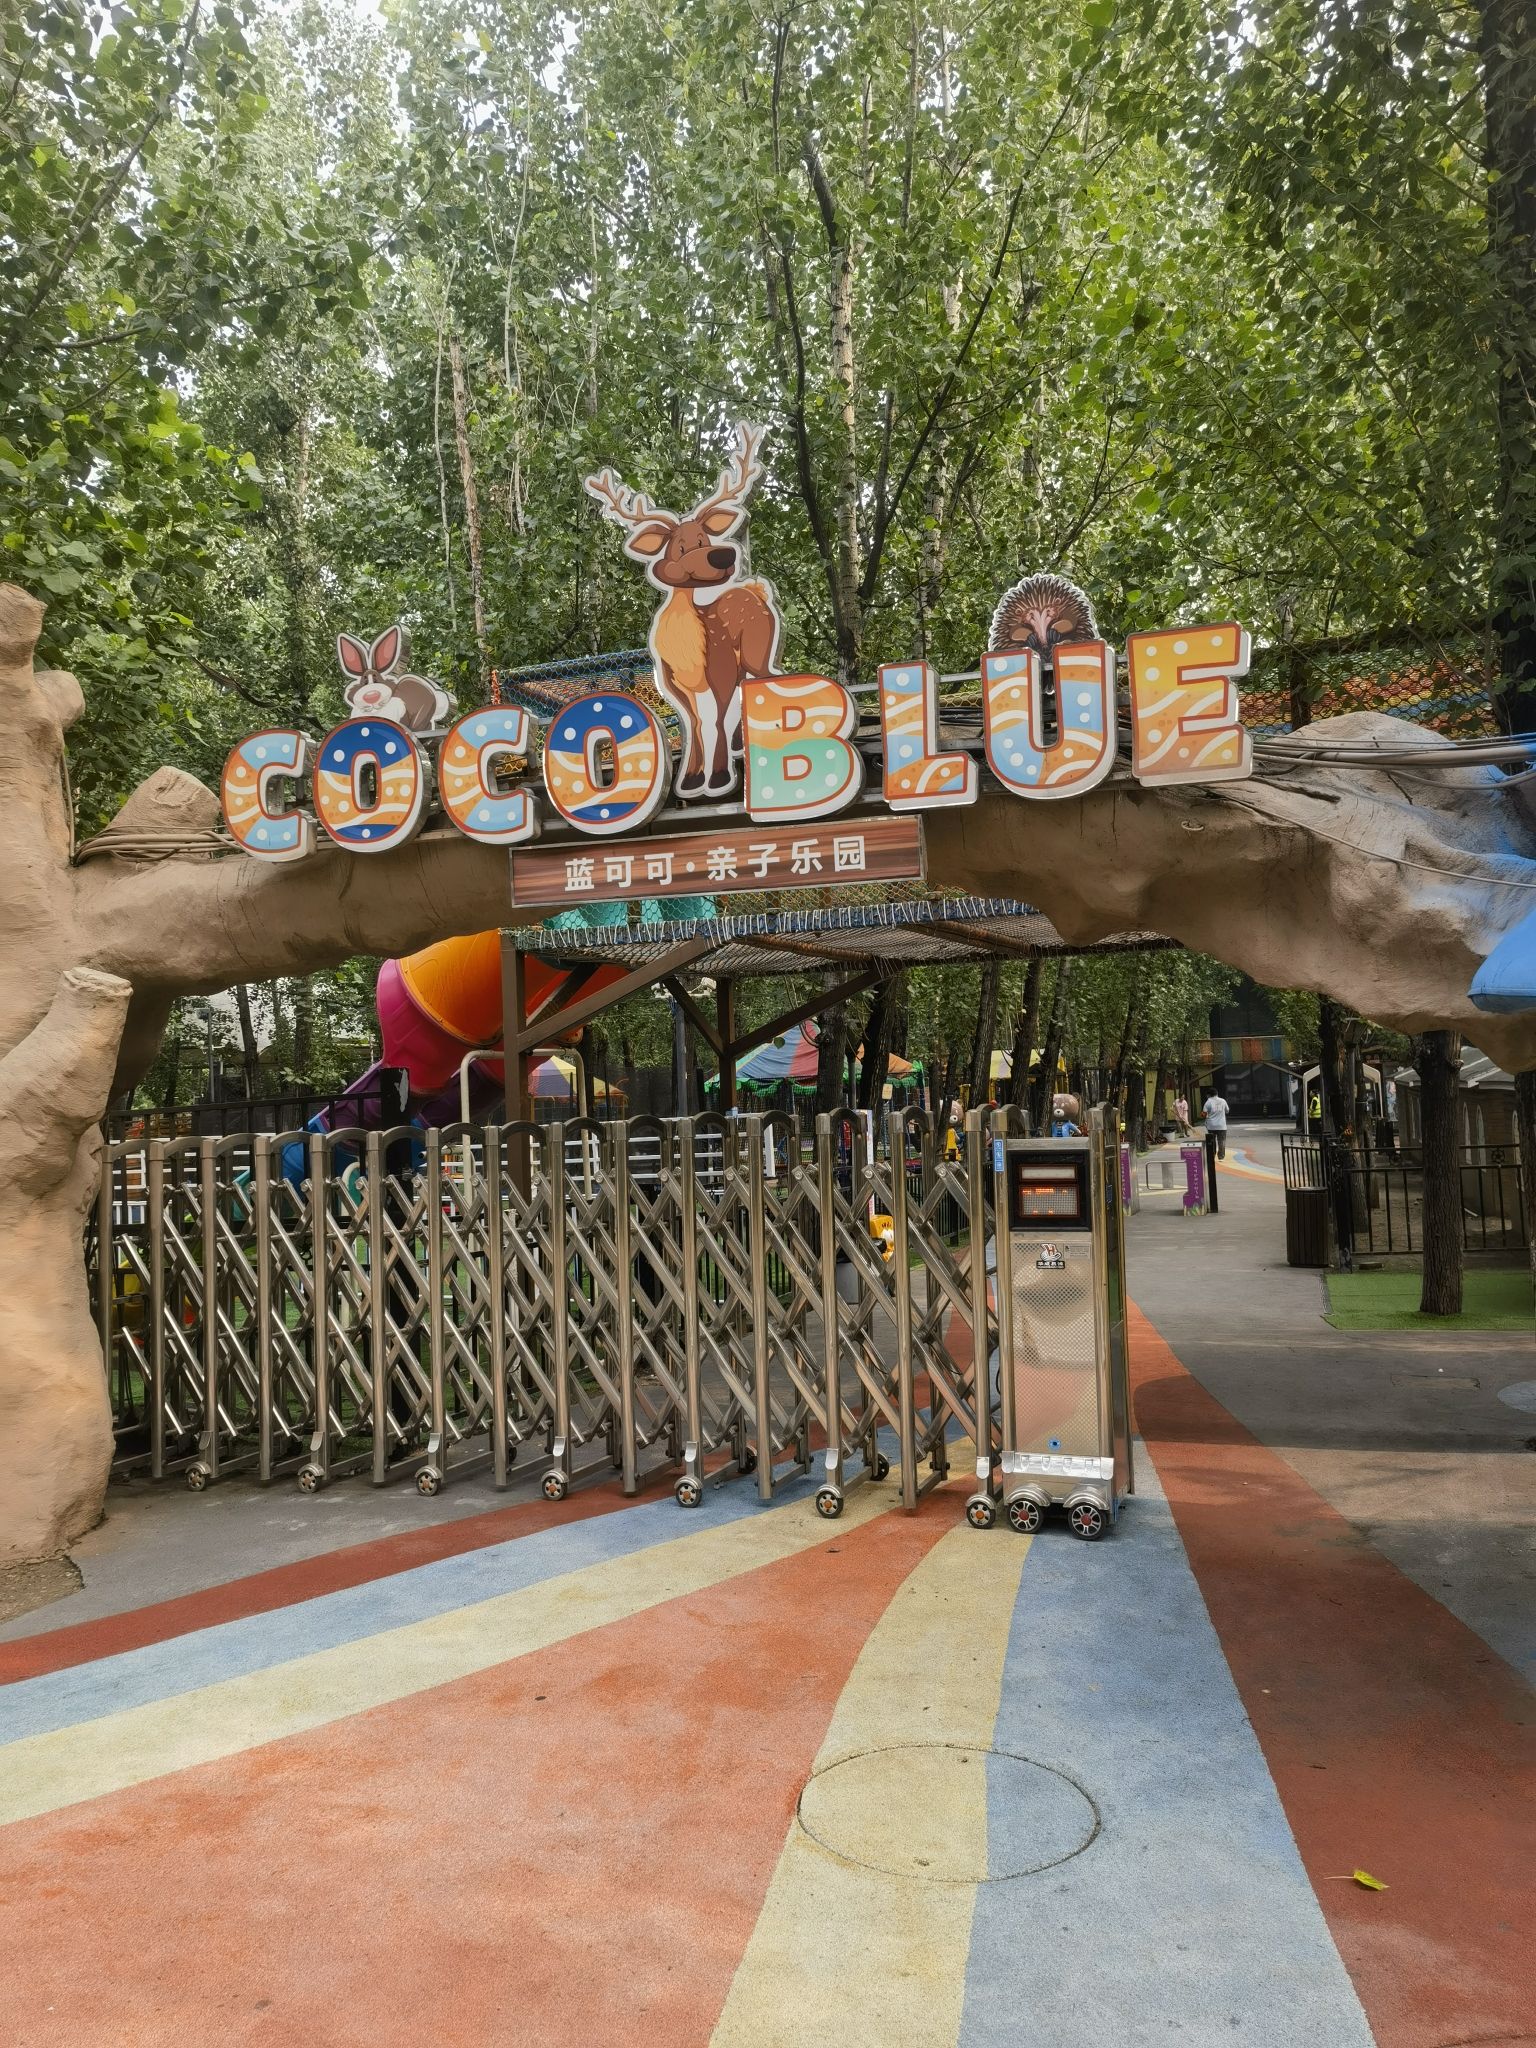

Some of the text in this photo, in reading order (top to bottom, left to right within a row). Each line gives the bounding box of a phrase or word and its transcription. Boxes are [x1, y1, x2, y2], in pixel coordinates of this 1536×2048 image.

[221, 621, 1254, 862] COCO BLUE
[564, 835, 866, 892] 蓝可可·亲子乐园
